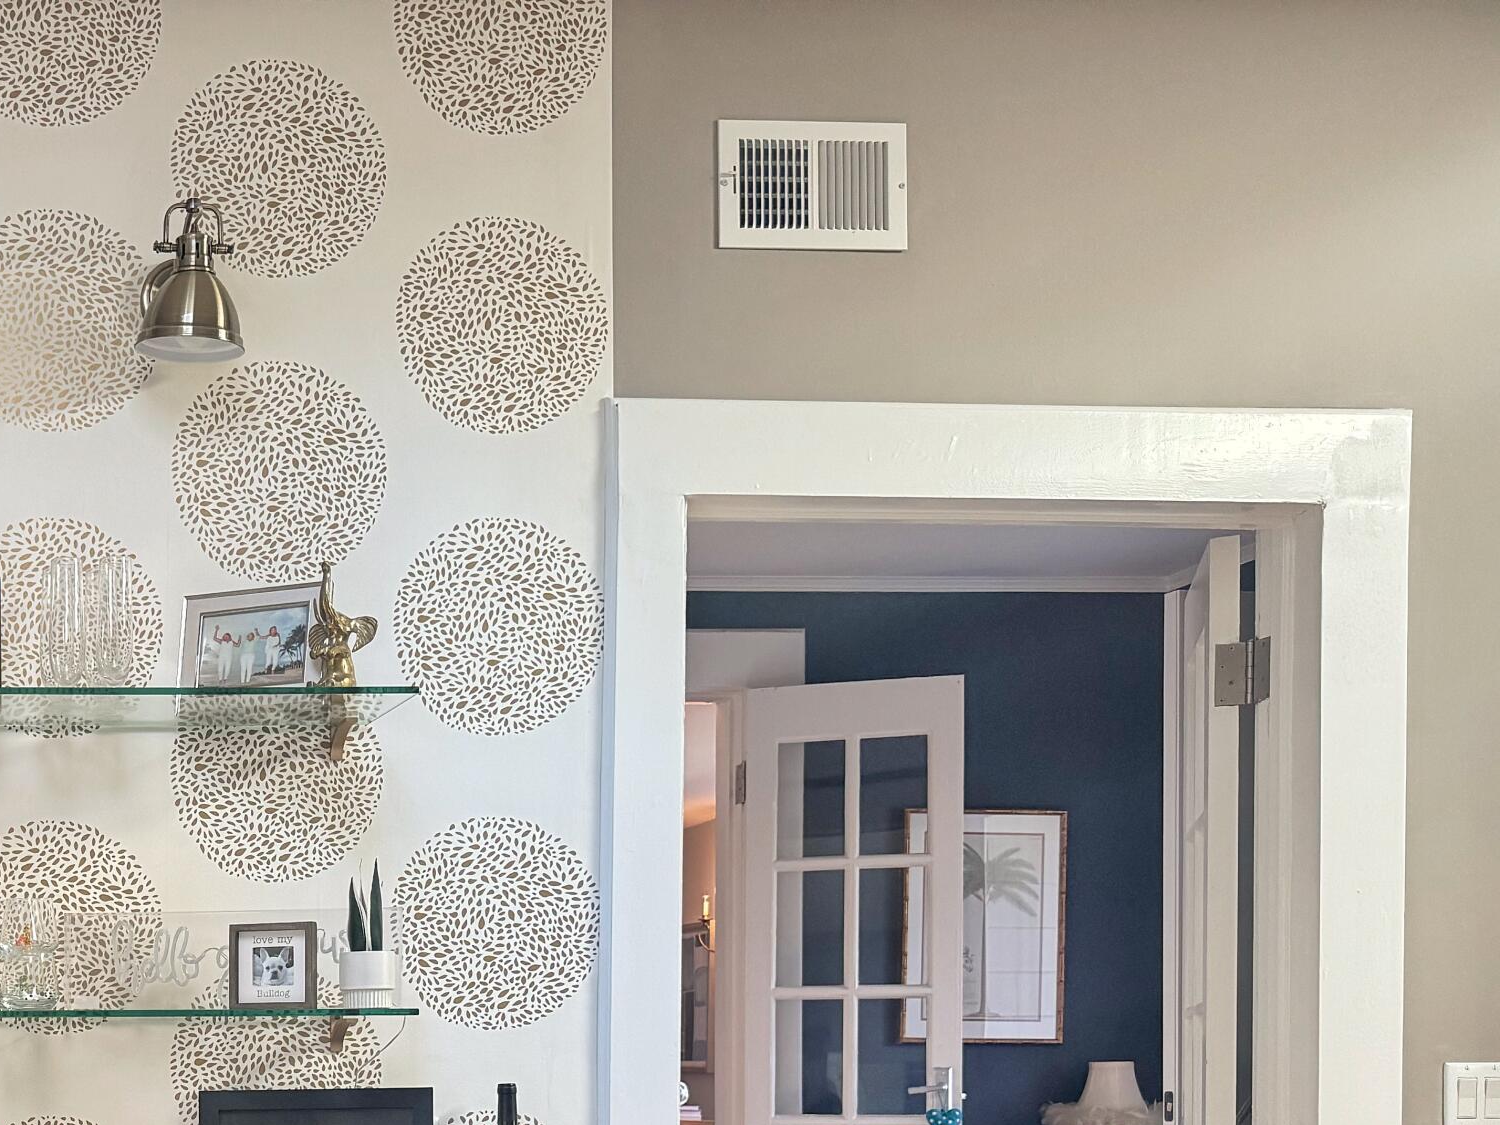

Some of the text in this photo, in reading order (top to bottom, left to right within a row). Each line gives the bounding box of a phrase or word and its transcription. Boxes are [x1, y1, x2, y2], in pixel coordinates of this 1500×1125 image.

[252, 936, 294, 944] love my
[257, 990, 291, 998] Bulldog
